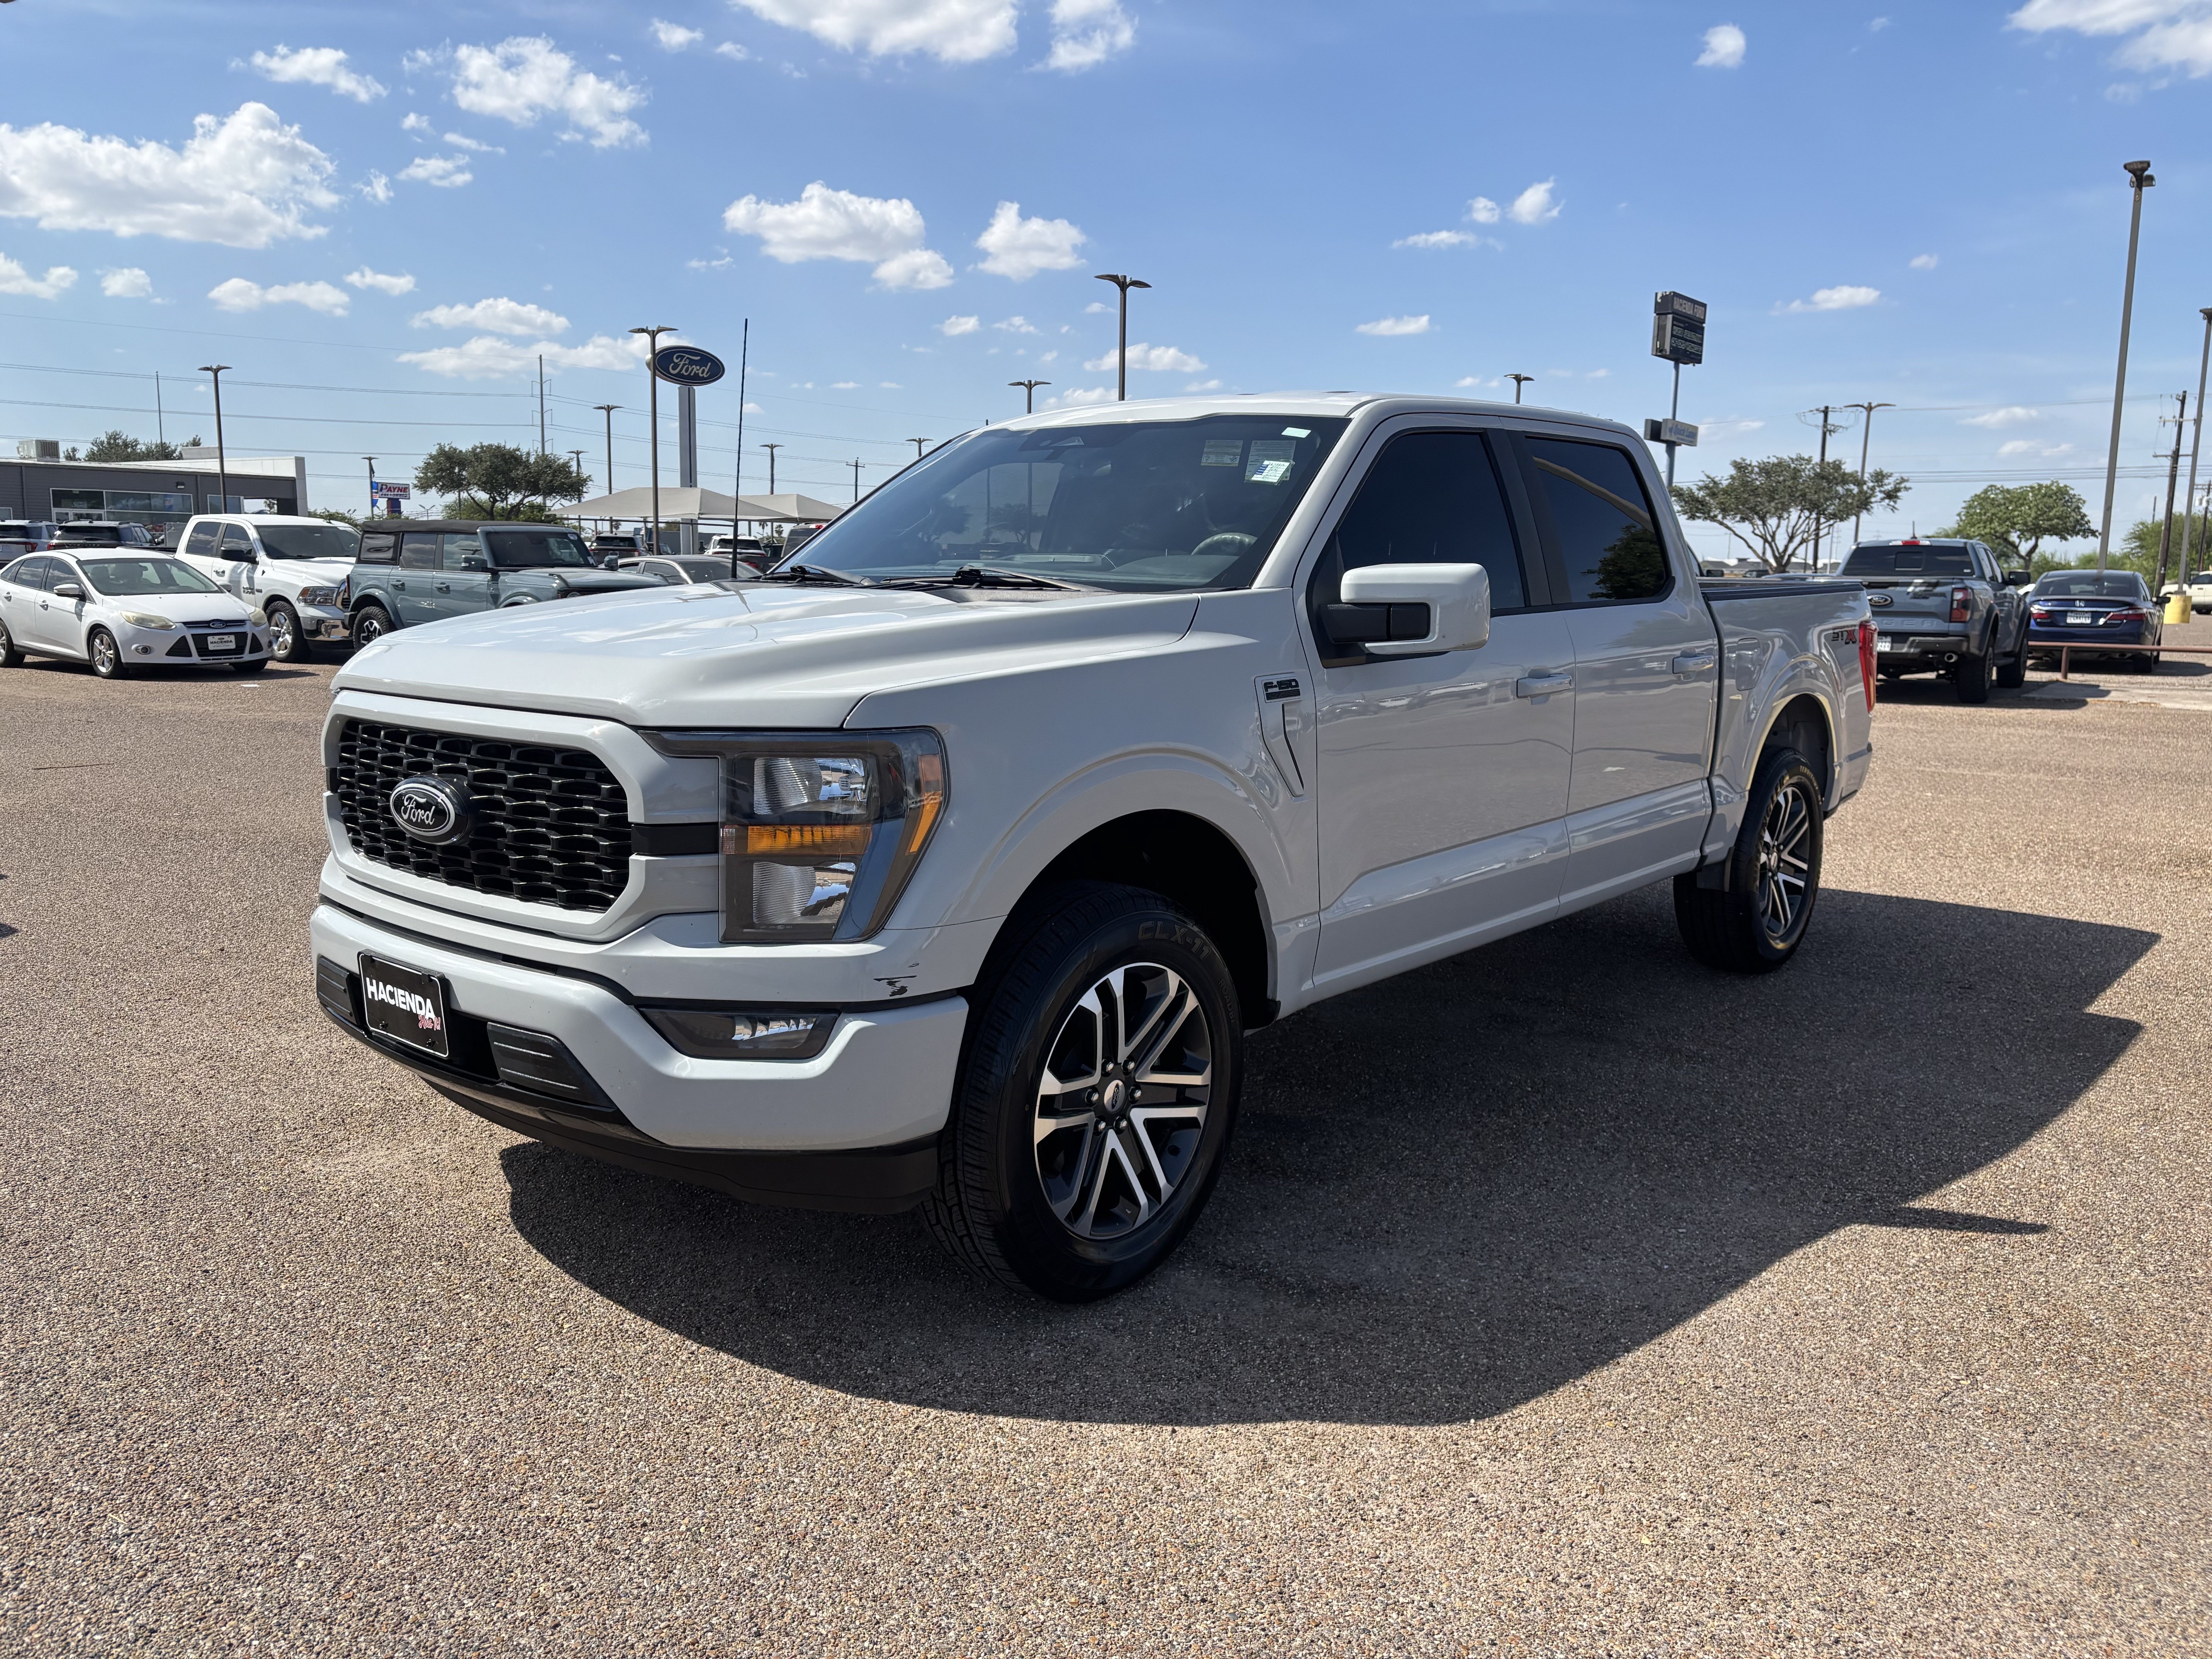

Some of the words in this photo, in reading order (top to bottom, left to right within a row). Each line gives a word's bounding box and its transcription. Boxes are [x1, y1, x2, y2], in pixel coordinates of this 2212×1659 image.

[669, 353, 711, 378] Ford
[380, 484, 408, 493] PAYNE
[1264, 678, 1299, 692] F-150
[401, 794, 435, 825] Ford
[1138, 921, 1211, 960] CLX-11
[366, 977, 436, 1021] HACIENDA
